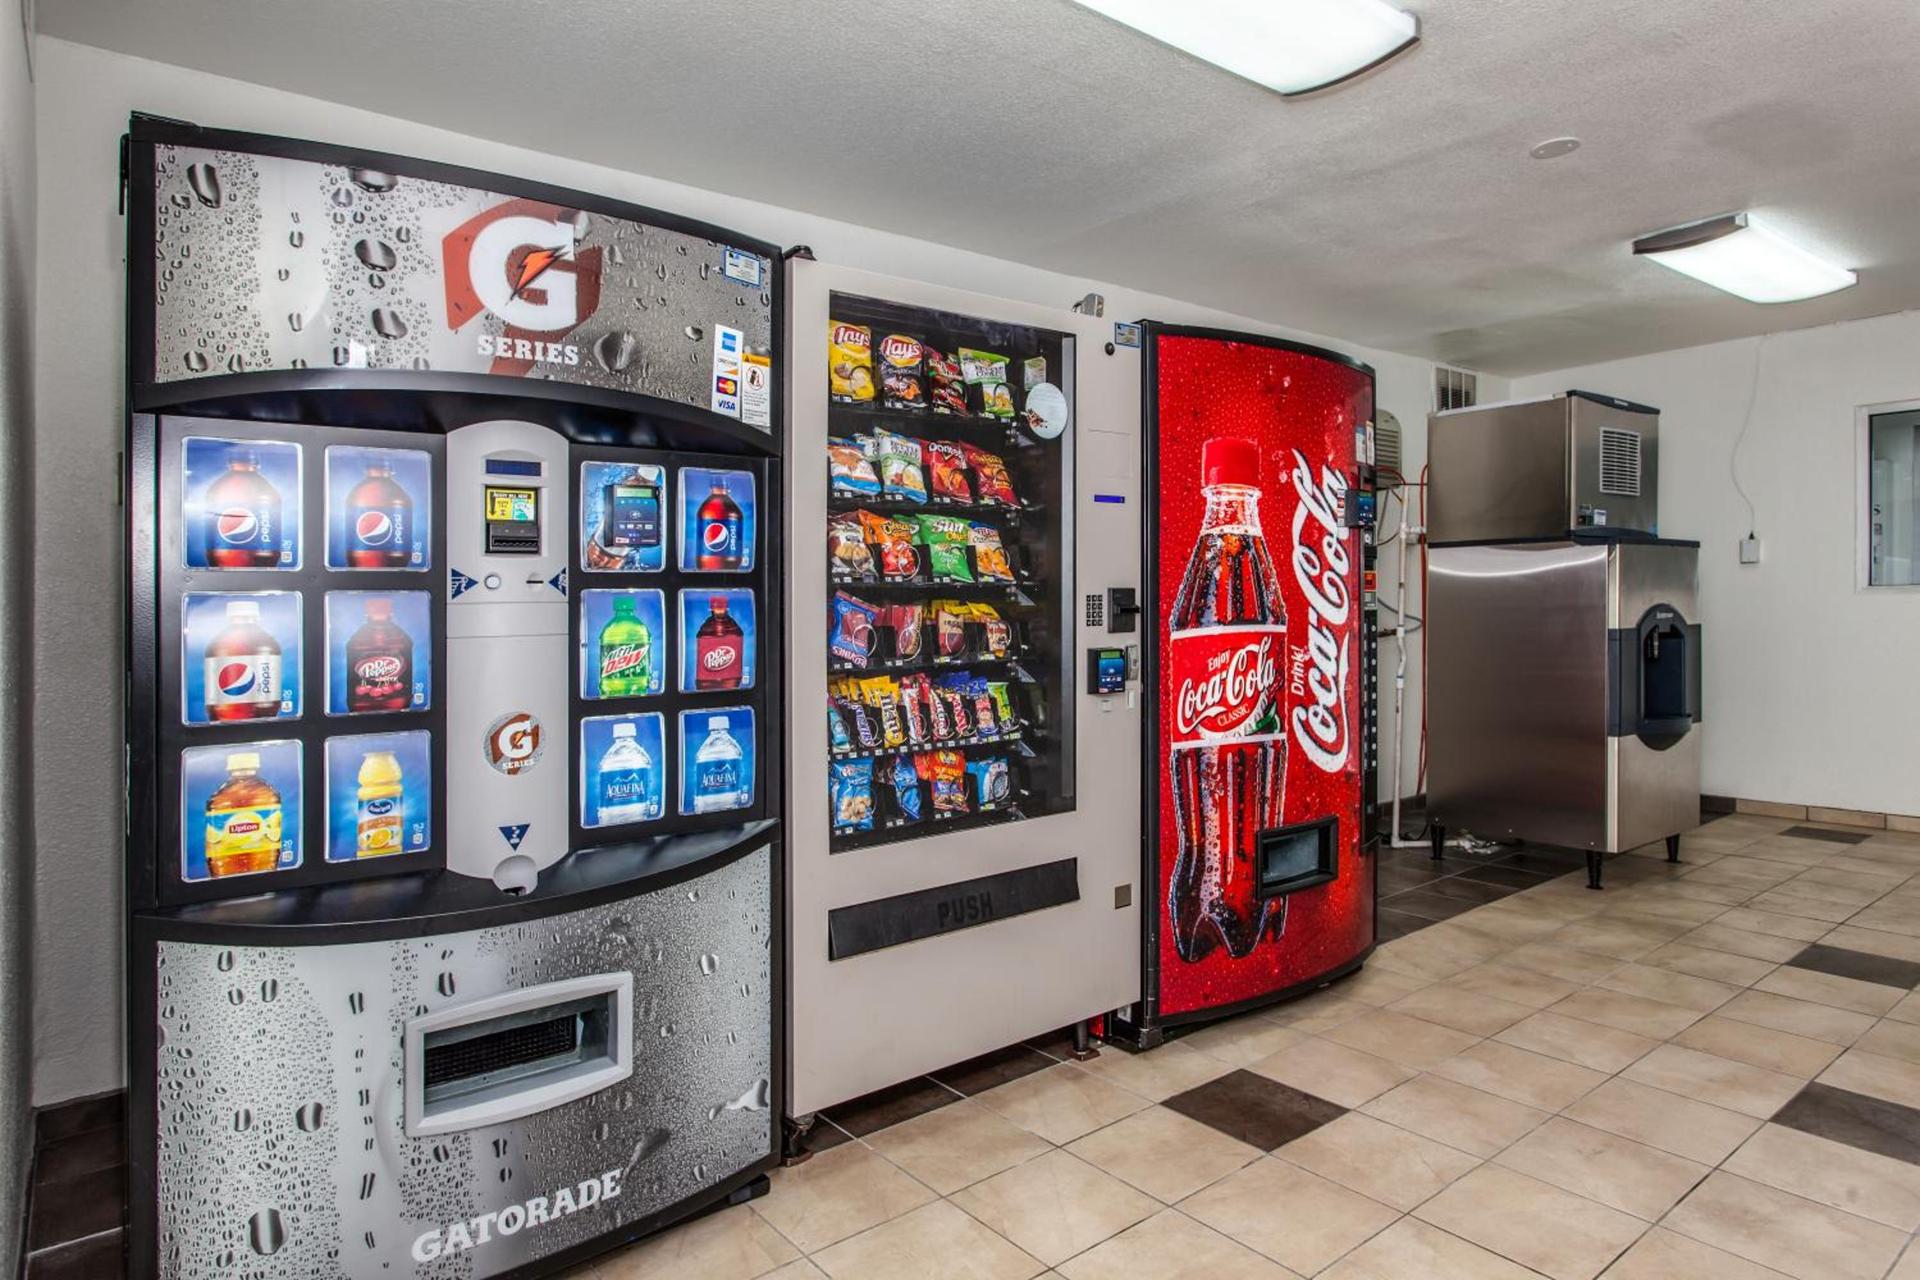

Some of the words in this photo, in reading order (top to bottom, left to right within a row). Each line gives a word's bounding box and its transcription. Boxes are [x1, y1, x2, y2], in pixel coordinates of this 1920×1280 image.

[467, 215, 578, 332] G
[476, 334, 579, 366] SERIES
[718, 399, 736, 411] VISA
[393, 513, 403, 543] pepsi
[931, 520, 965, 533] Sun
[1292, 447, 1349, 772] Coca-Cola
[1207, 649, 1231, 672] Enjoy
[262, 662, 271, 694] pepsi
[1177, 635, 1275, 735] Coca-Cola
[1217, 703, 1251, 727] CLASSIC
[502, 757, 535, 770] SERIES
[607, 782, 645, 798] AQUAFINA
[702, 770, 737, 788] AQUAFINA
[230, 823, 258, 833] Lipton
[936, 891, 993, 929] PUSH
[411, 1168, 623, 1263] GATORADE
